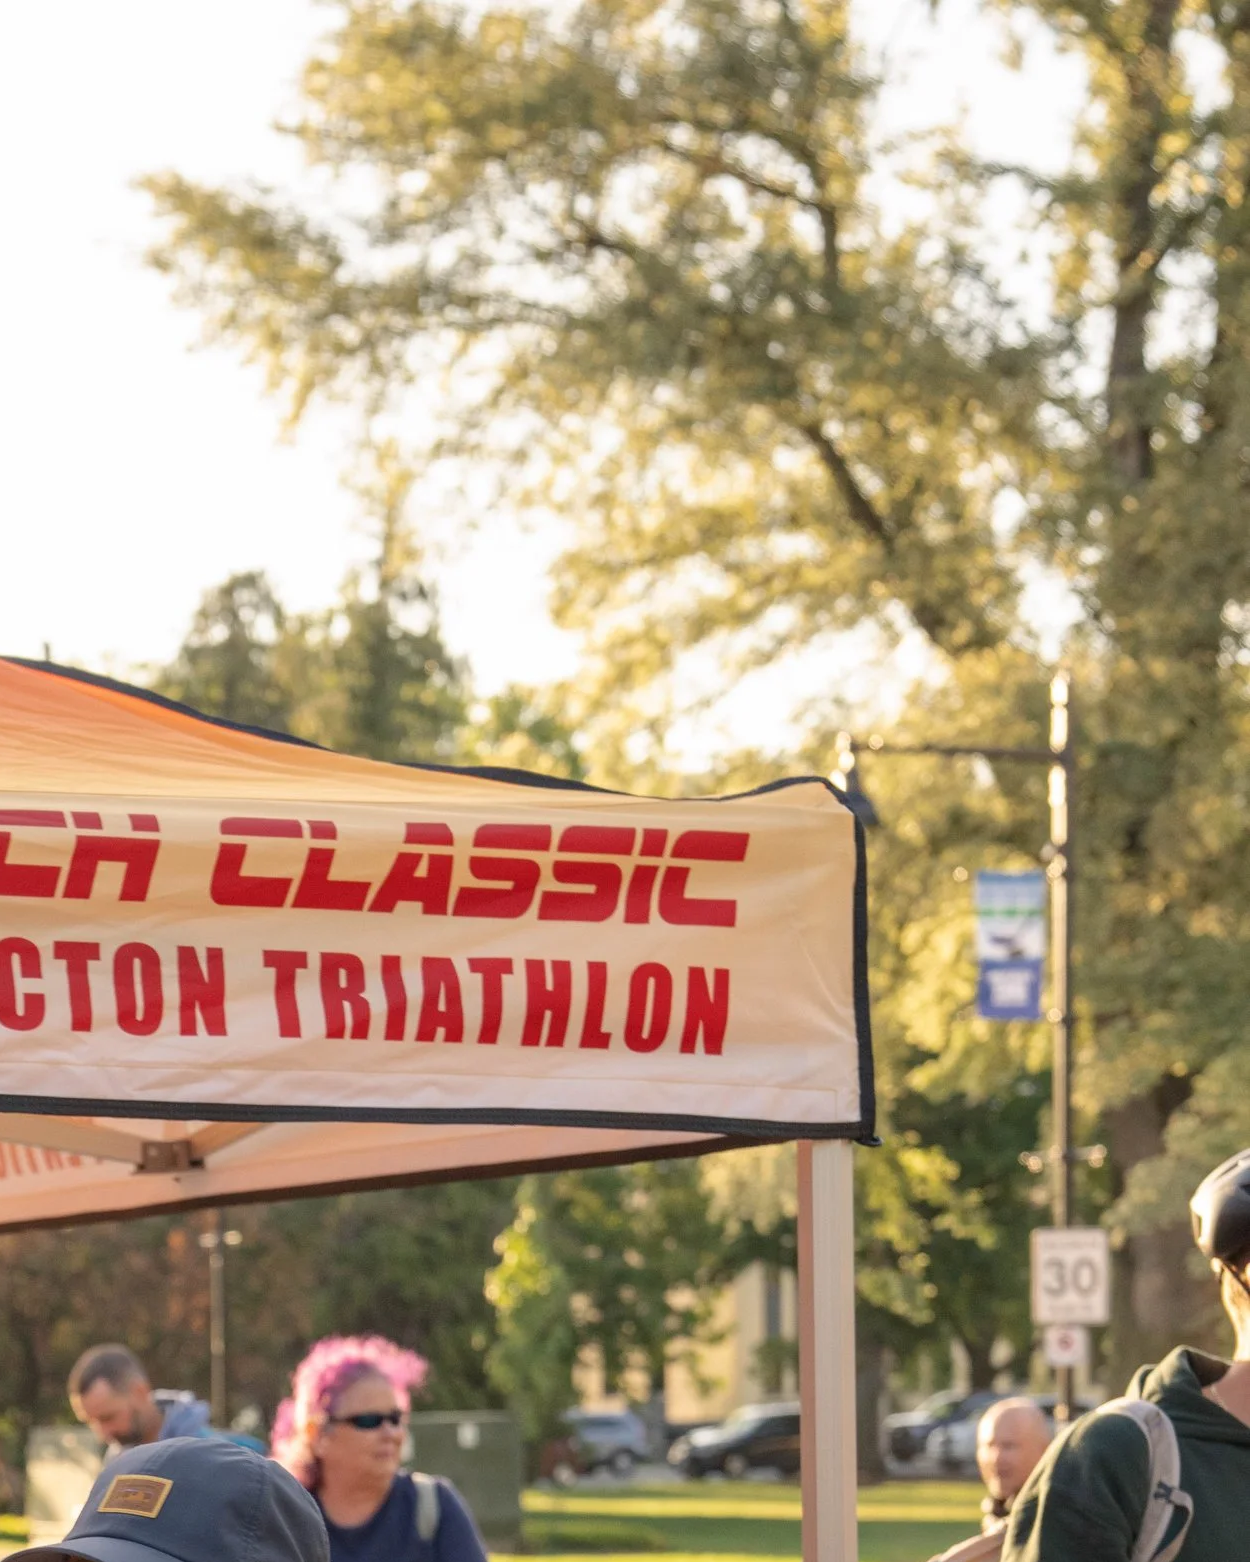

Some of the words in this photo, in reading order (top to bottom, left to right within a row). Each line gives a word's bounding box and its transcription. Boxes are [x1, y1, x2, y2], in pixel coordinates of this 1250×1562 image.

[208, 817, 751, 929] CLASSIC
[262, 949, 731, 1057] TRIATHLON
[1042, 1256, 1098, 1299] 30
